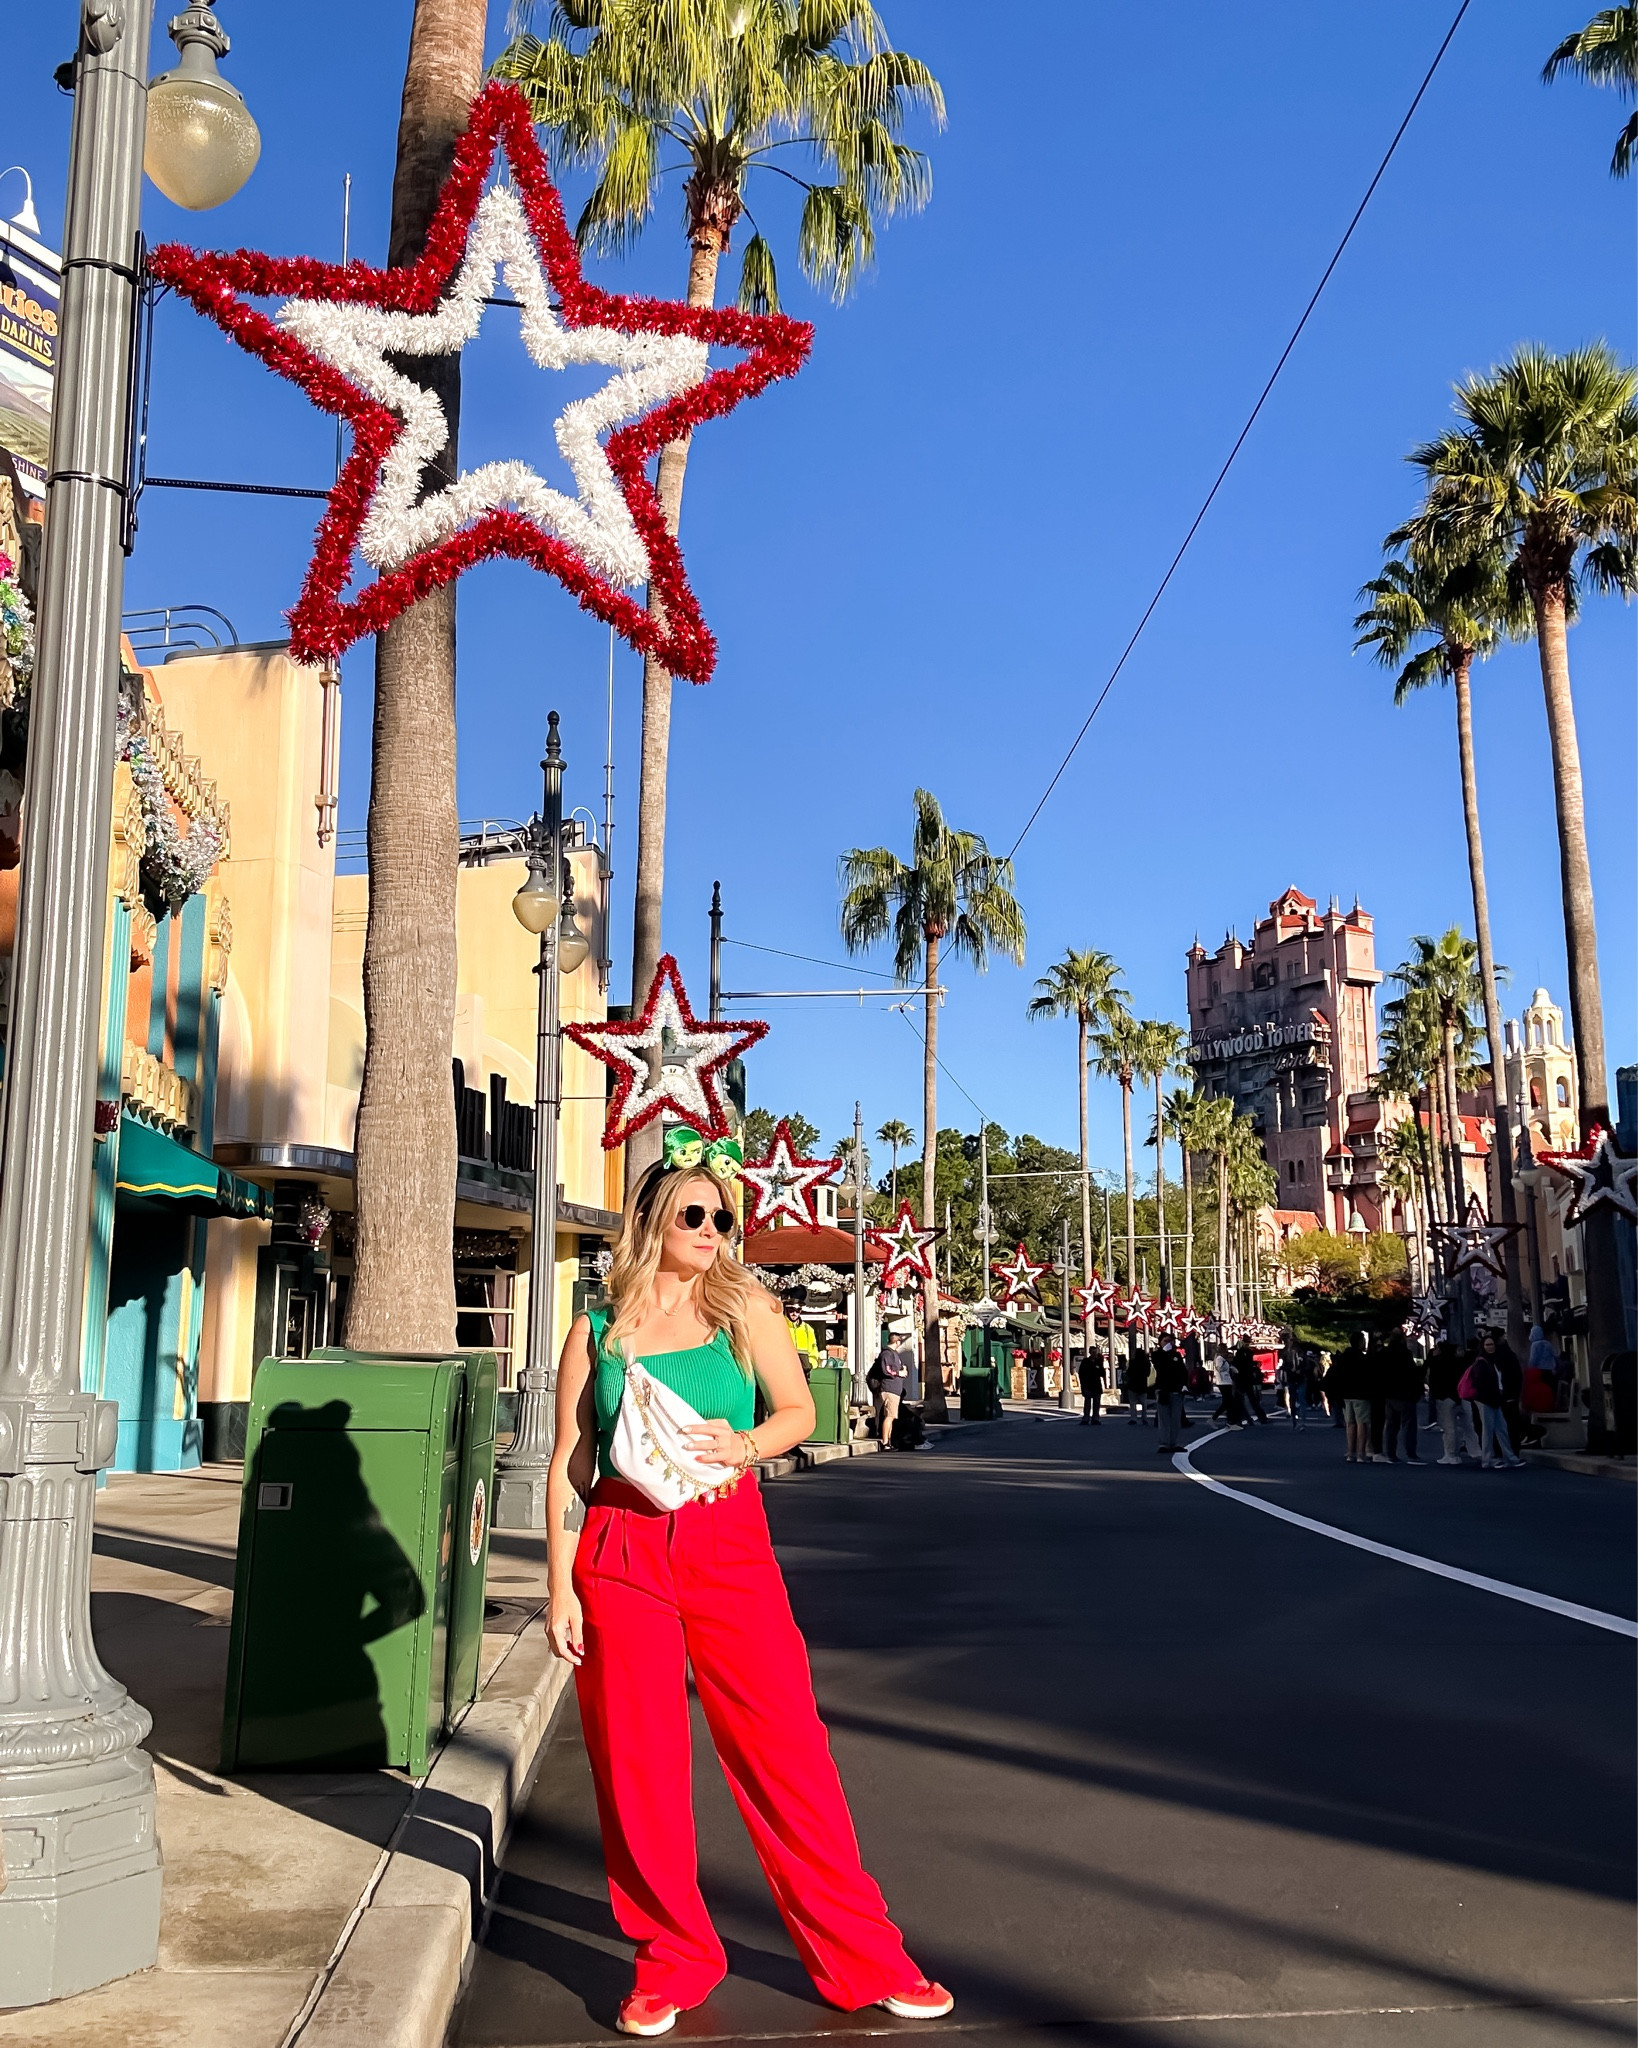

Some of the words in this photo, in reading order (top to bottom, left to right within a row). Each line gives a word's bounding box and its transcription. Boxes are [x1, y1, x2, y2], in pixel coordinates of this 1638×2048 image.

[0, 281, 58, 336] ties
[1, 314, 52, 358] DARINS
[1267, 1022, 1316, 1048] TOWER
